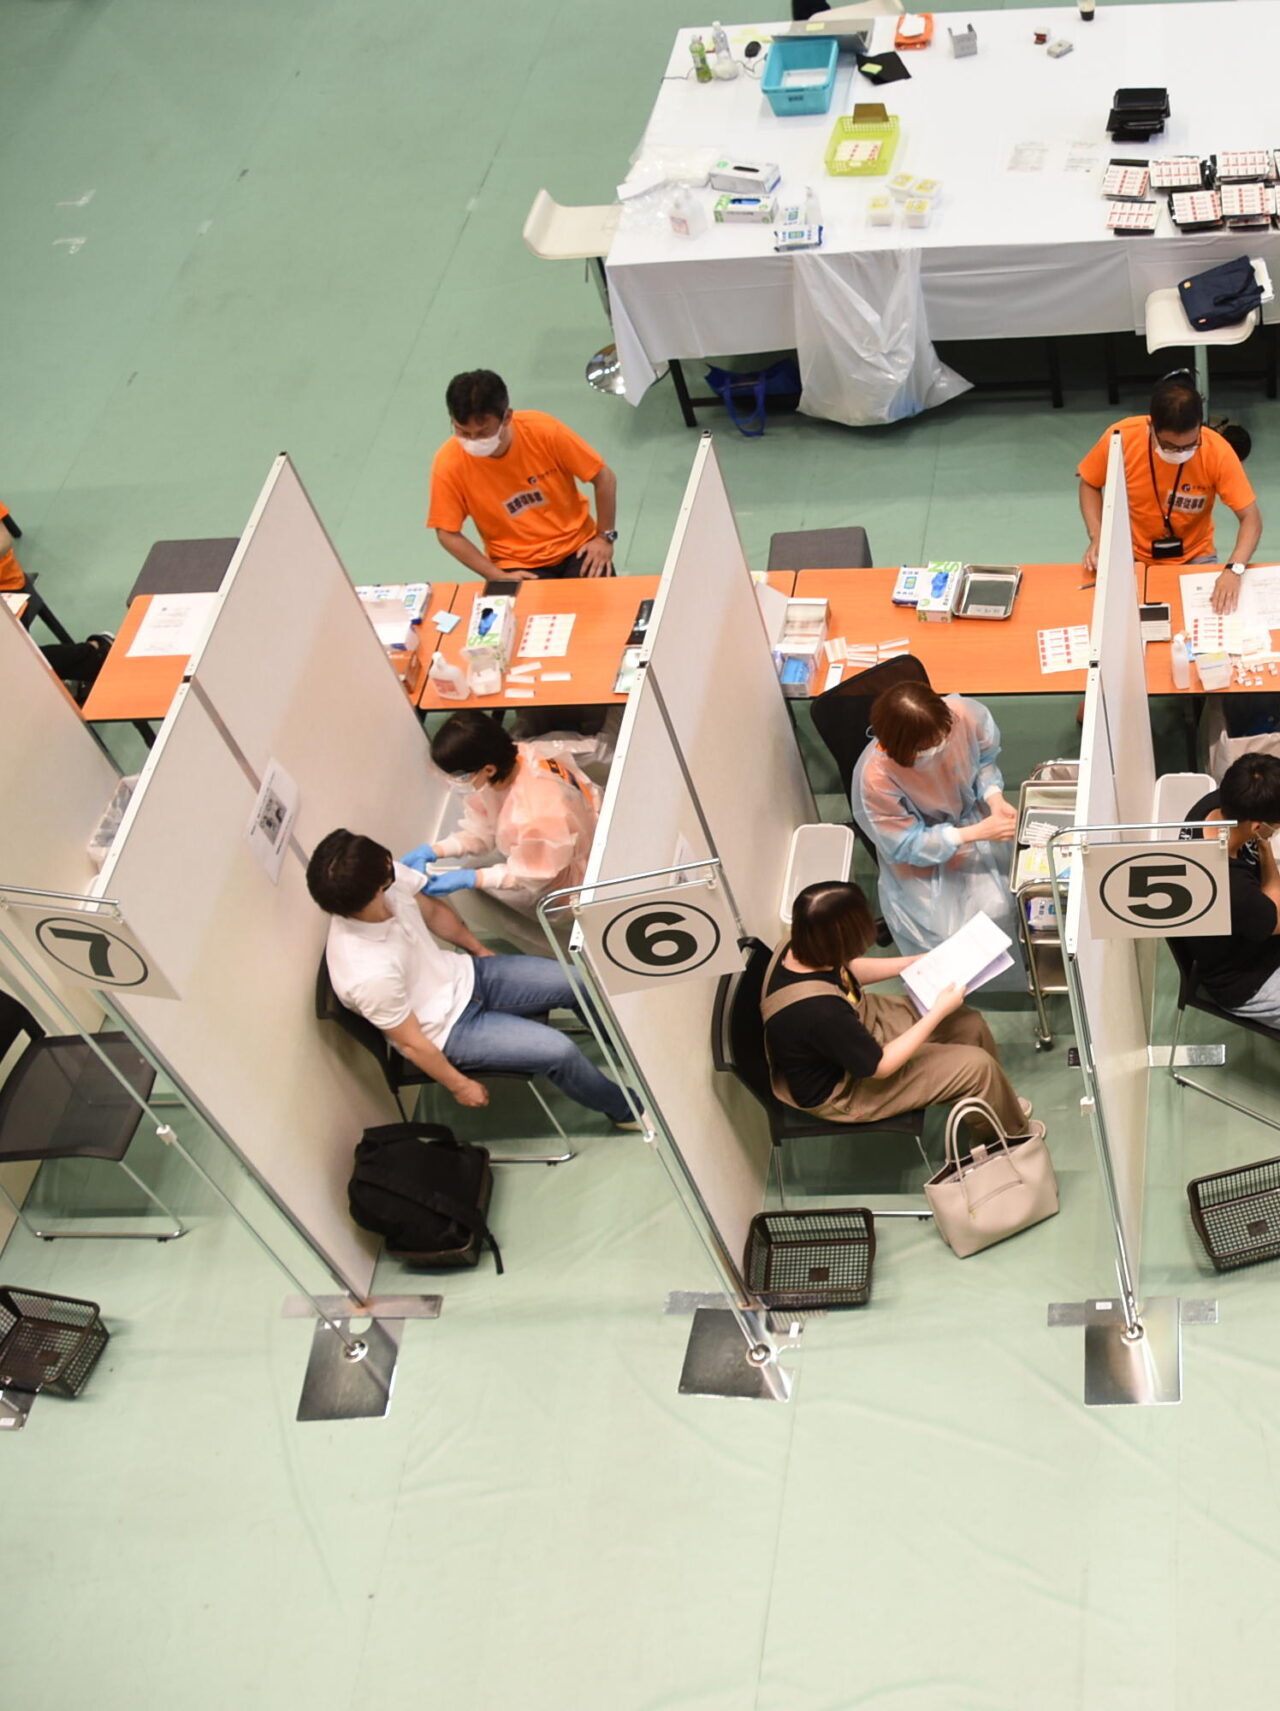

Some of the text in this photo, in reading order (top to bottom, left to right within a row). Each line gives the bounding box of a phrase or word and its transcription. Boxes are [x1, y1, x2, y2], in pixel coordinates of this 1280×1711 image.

[1127, 864, 1193, 920] 5
[48, 926, 116, 978] 7
[625, 911, 698, 966] 6
